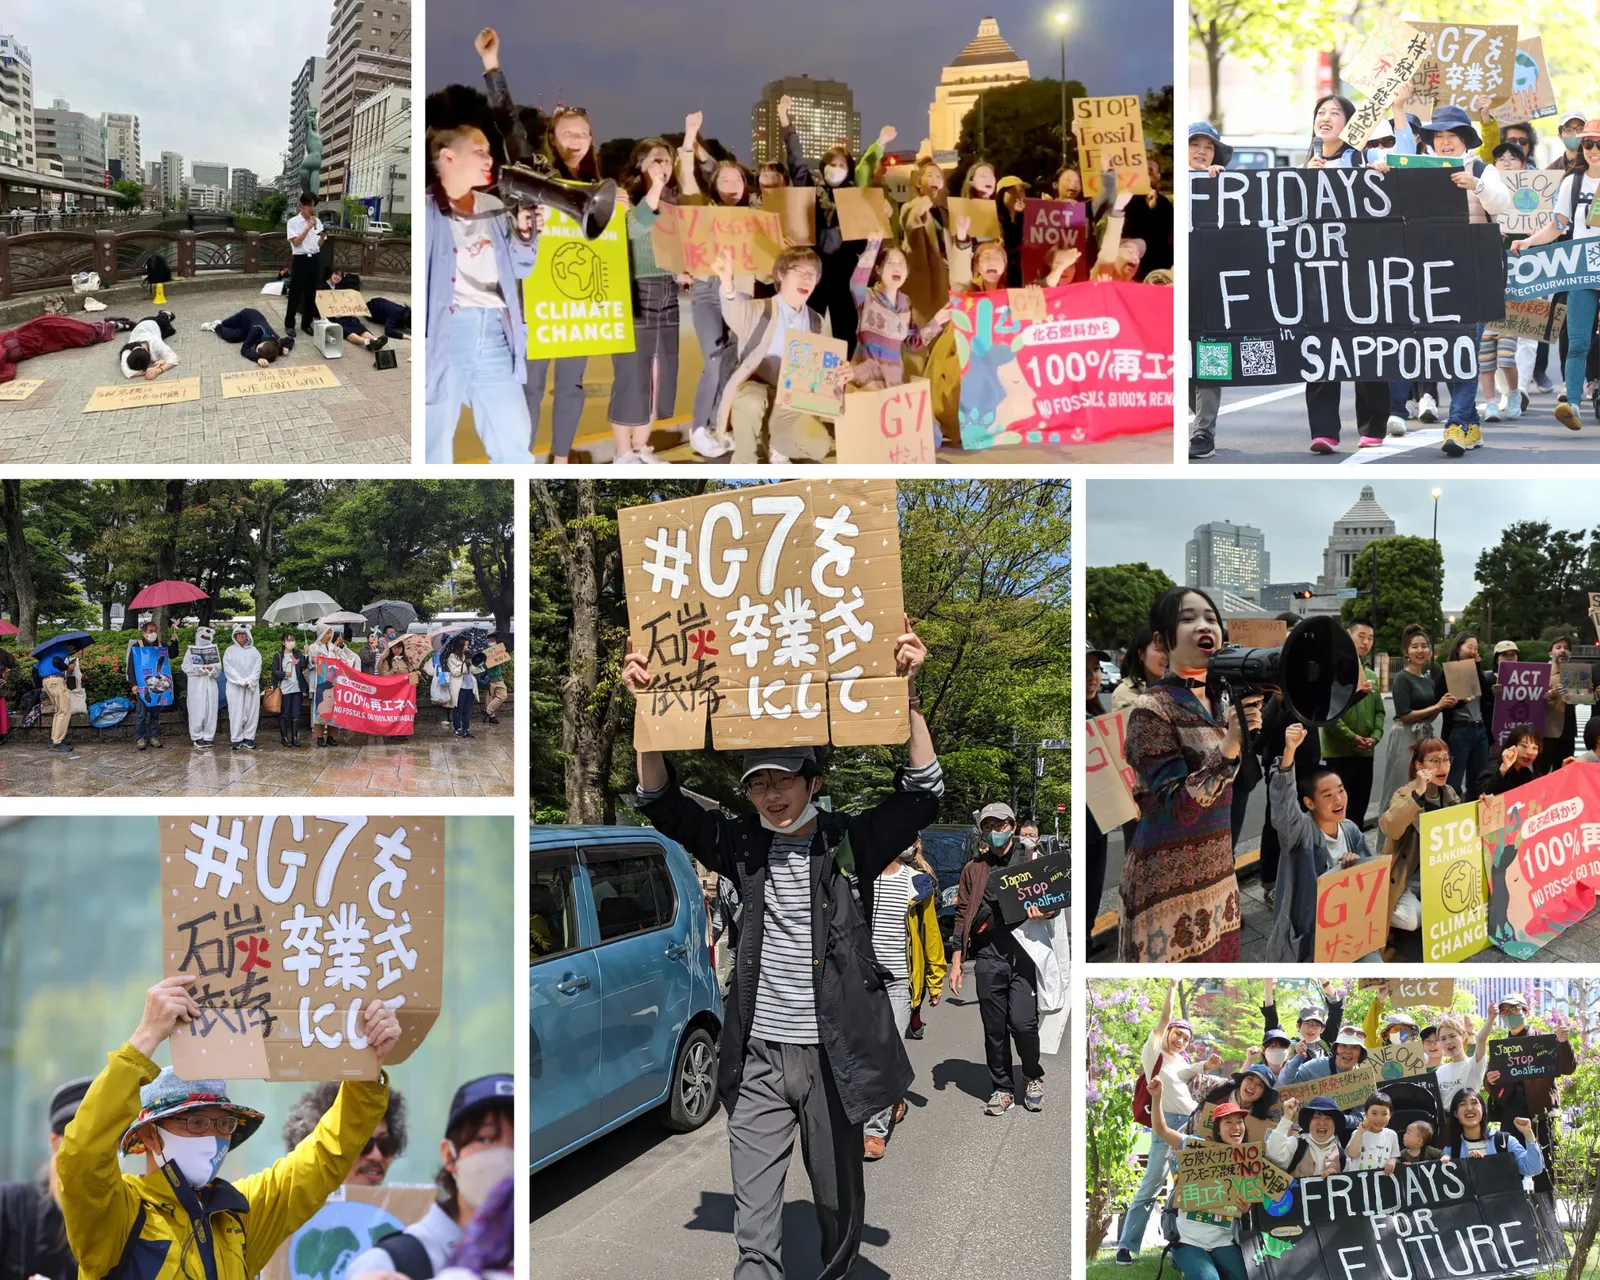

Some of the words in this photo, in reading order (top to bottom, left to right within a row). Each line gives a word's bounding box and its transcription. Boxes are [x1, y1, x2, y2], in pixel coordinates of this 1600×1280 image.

[1349, 33, 1427, 146] 持続可能発電
[1445, 62, 1503, 93] 卒業式
[1078, 97, 1137, 118] STOP
[1079, 122, 1140, 146] Fossil
[1035, 208, 1073, 226] ACT
[1189, 169, 1391, 233] FRIDAYS
[1030, 226, 1079, 246] NOW
[1266, 222, 1349, 264] FOR
[1507, 244, 1582, 285] POW
[1219, 257, 1461, 329] FUTURE
[535, 301, 625, 320] CLIMATE
[536, 322, 627, 343] CHANGE
[1032, 321, 1111, 343] 化石燃料から
[1280, 328, 1296, 341] in
[1300, 336, 1478, 382] SAPPORO
[880, 389, 928, 438] G7
[642, 495, 860, 599] #G7を
[641, 602, 720, 667] 石炭
[726, 585, 875, 669] 卒業式
[1231, 621, 1250, 631] WE
[1258, 621, 1283, 633] WANT
[645, 659, 727, 717] 依存
[747, 665, 869, 720] にして
[1502, 685, 1544, 701] NOW
[1508, 669, 1542, 686] ACT
[336, 688, 415, 712] 100%再エネへ
[1482, 800, 1501, 826] G7
[1429, 817, 1476, 852] STO
[184, 816, 412, 920] #G7を
[1429, 843, 1473, 867] BANKING
[1000, 871, 1033, 890] Japan
[1017, 881, 1049, 900] STOP
[1531, 889, 1544, 909] NO
[1575, 865, 1588, 881] GO
[1317, 866, 1388, 929] G7
[1430, 903, 1489, 940] CLIMATE
[177, 903, 272, 978] 石炭
[280, 902, 419, 992] 卒業式
[1323, 920, 1379, 962] サミット
[1400, 981, 1439, 998] にして
[1367, 1046, 1393, 1074] AVE
[1396, 1046, 1425, 1075] OUR
[1494, 1043, 1523, 1057] Japan
[1507, 1055, 1534, 1067] STOP
[1233, 1146, 1259, 1162] NO
[1240, 1161, 1261, 1177] NO
[1182, 1179, 1233, 1209] 再エネ?
[1231, 1175, 1264, 1201] YES
[1300, 1161, 1466, 1226] FRIDAYS
[1370, 1208, 1438, 1240] FOR
[1338, 1220, 1539, 1280] FUTURE
